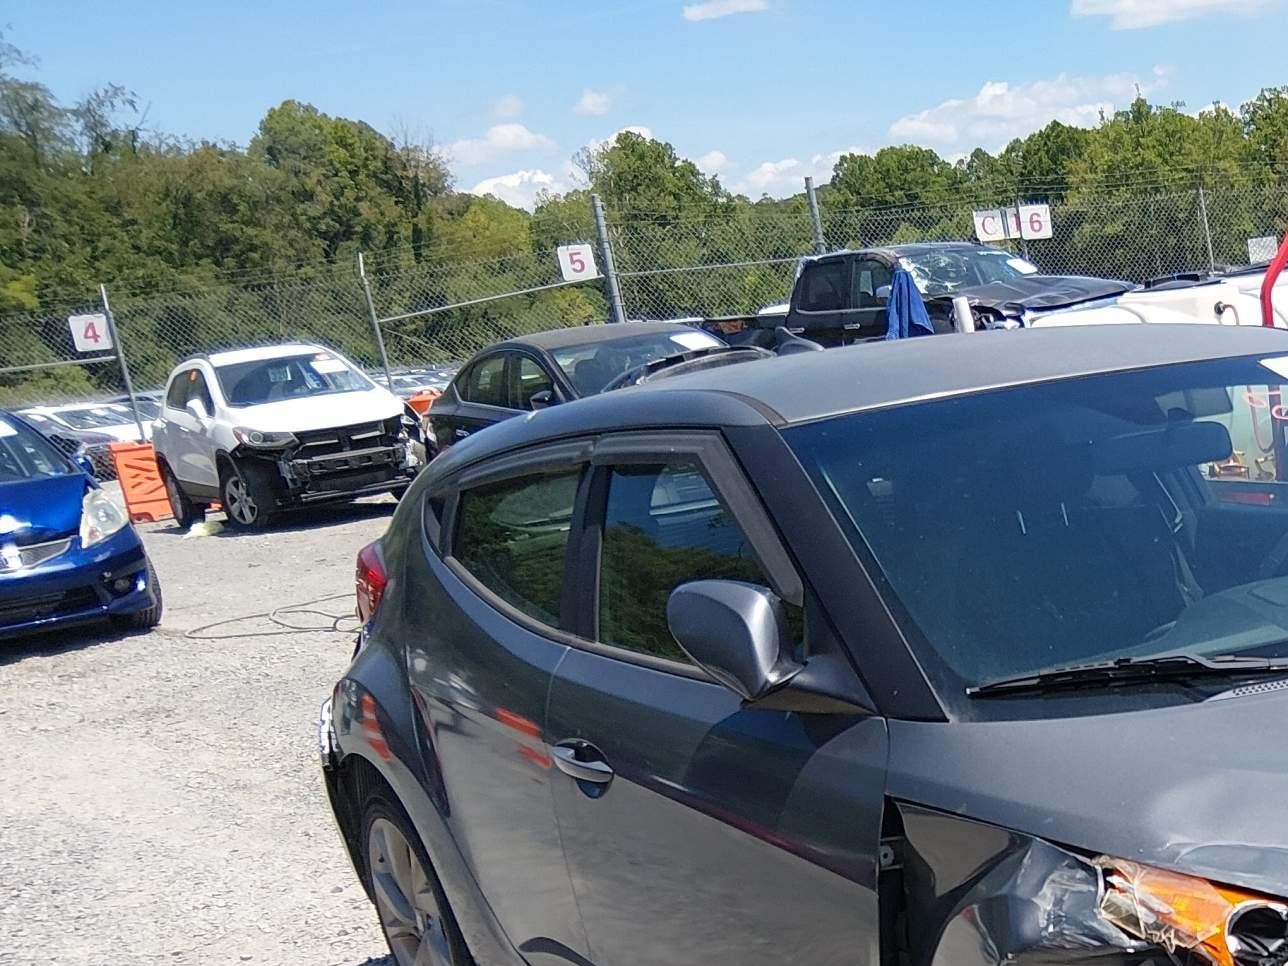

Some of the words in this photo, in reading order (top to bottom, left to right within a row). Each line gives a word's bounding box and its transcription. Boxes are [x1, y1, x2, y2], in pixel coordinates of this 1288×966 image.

[981, 215, 998, 236] C
[1028, 212, 1043, 233] 6
[568, 251, 586, 273] 5
[83, 322, 101, 343] 4
